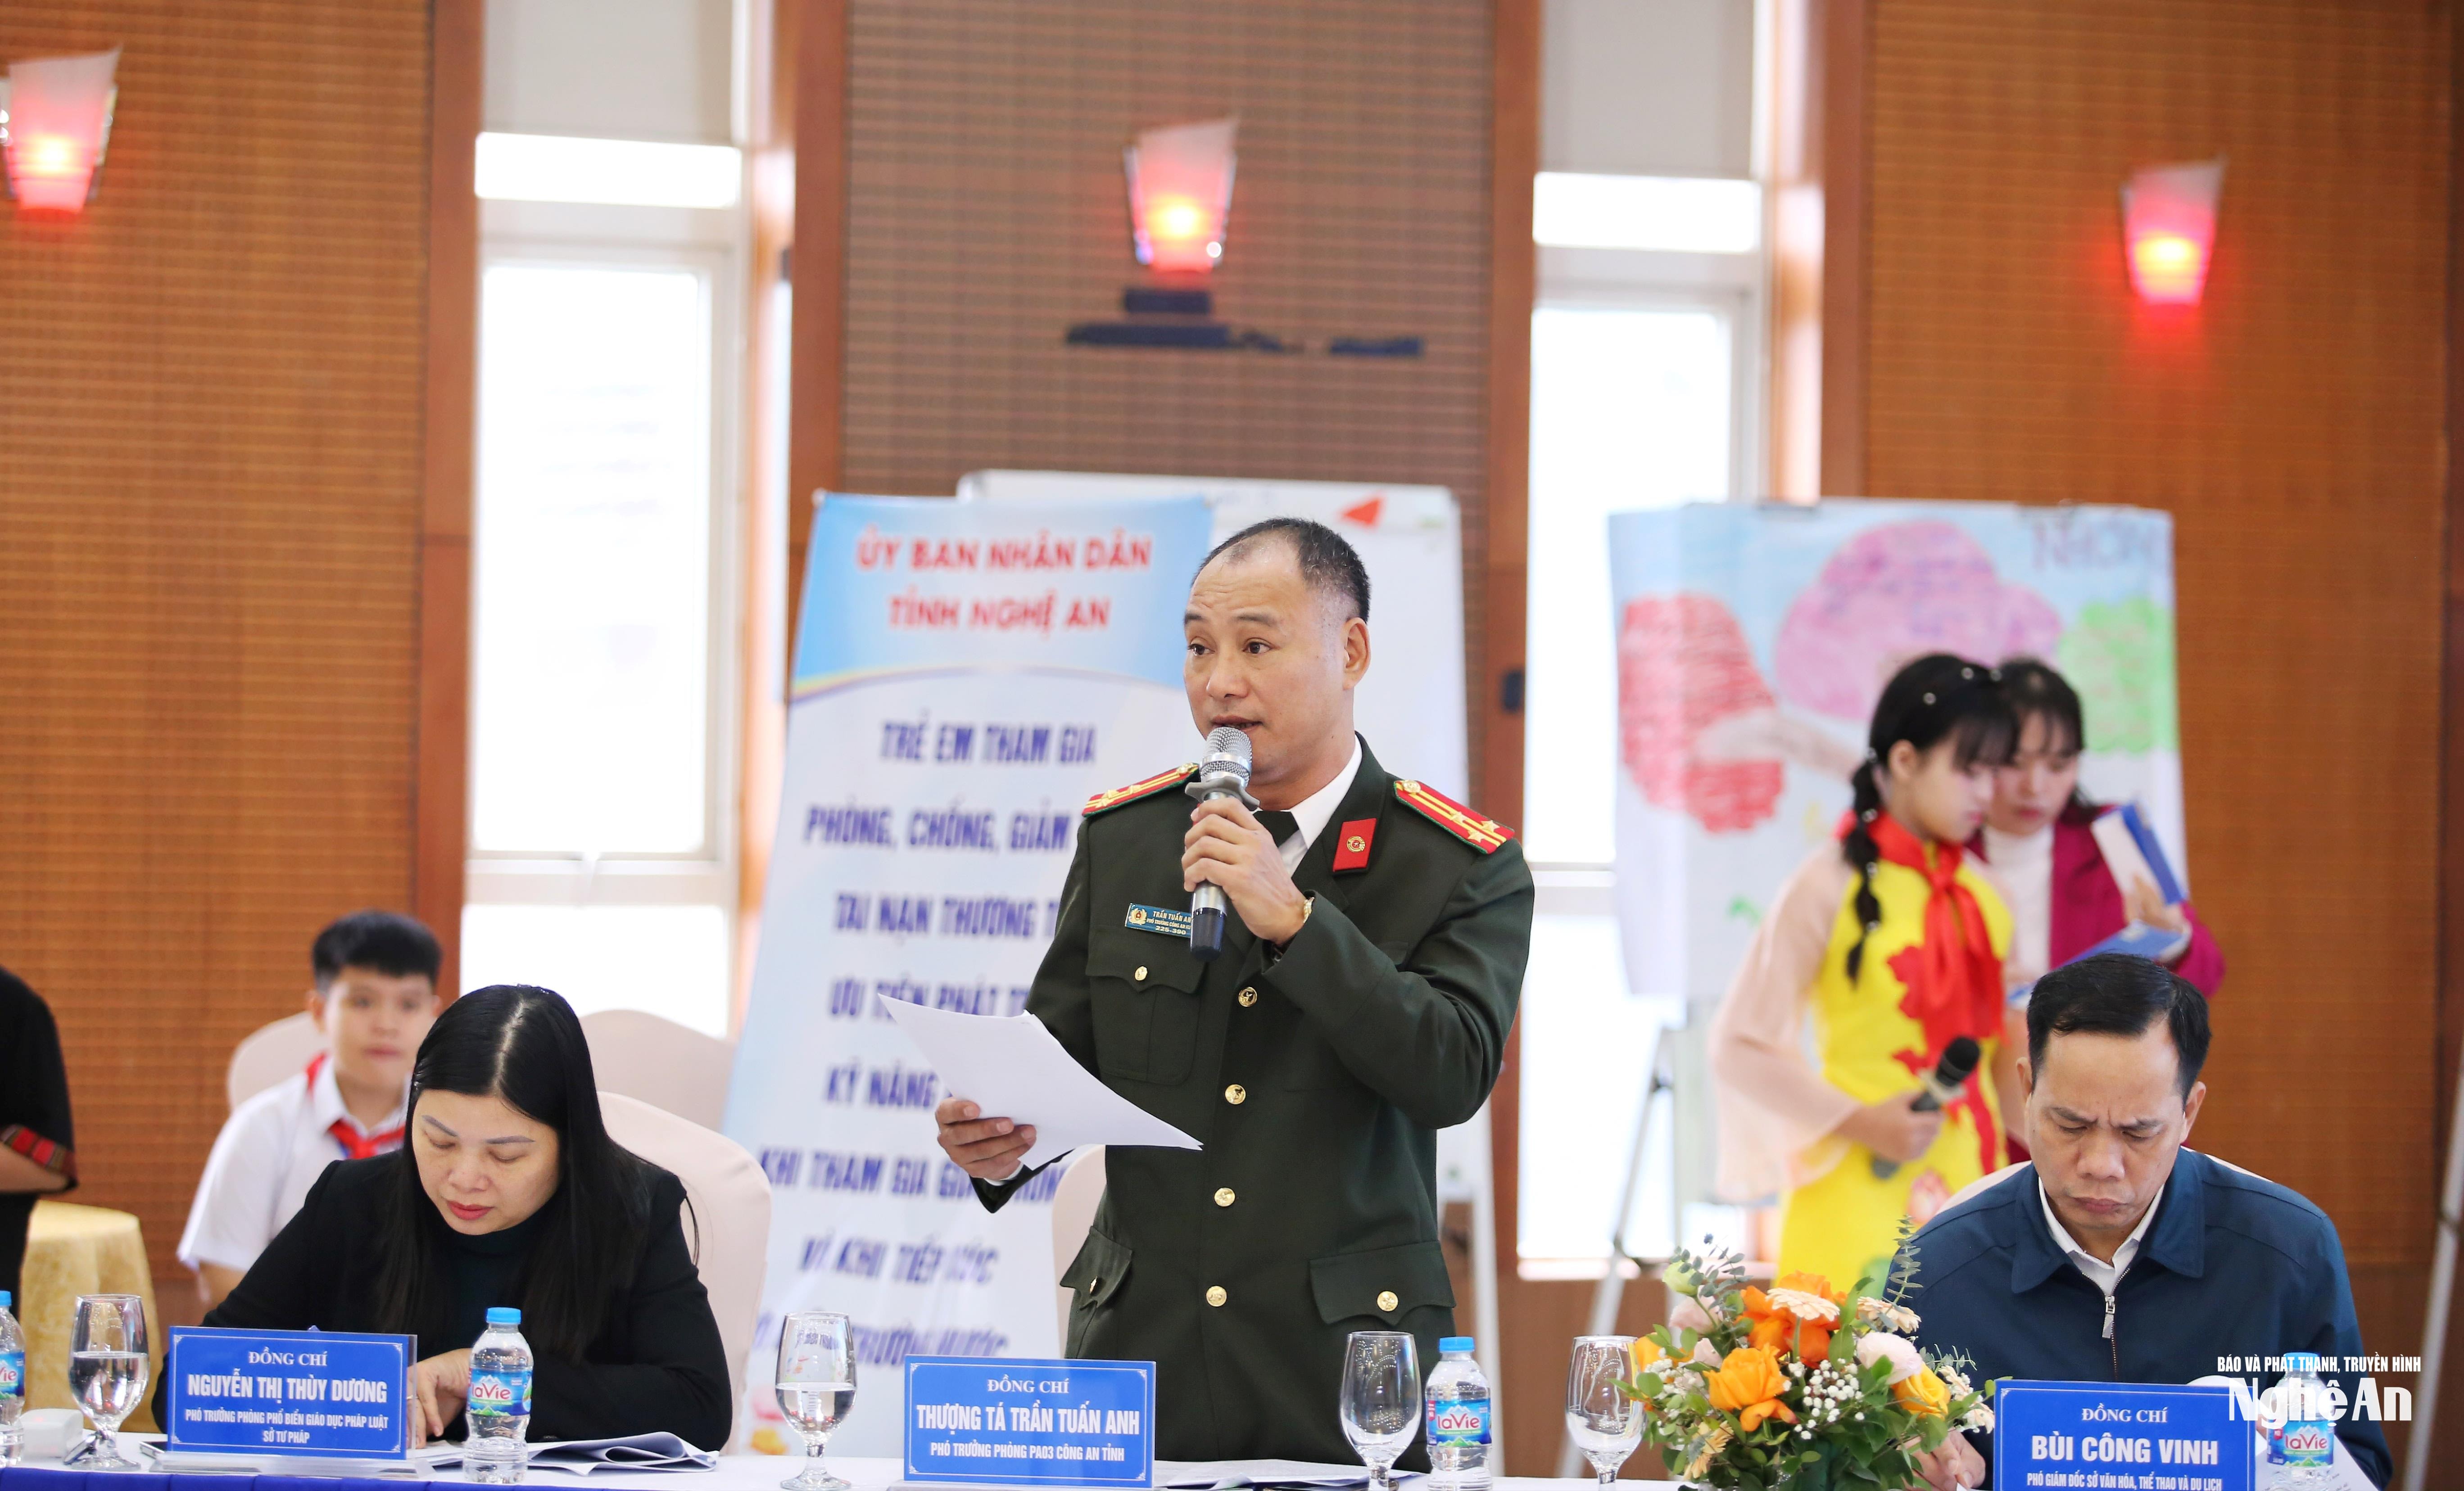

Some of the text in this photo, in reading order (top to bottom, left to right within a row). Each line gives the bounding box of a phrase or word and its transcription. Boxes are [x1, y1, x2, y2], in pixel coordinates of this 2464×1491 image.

[910, 537, 980, 569] BAN
[986, 528, 1076, 569] NHÂN
[1082, 526, 1151, 569] DÂN
[968, 587, 1056, 640] NGHỆ
[1064, 596, 1110, 628] AN
[935, 722, 975, 762] EM
[984, 723, 1051, 763] THAM
[1058, 725, 1096, 764] GIA
[809, 1150, 886, 1193] THAM
[892, 1155, 929, 1197] GIA
[248, 1346, 327, 1366] ĐỒNG CHÍ
[188, 1368, 387, 1404] NGUYỄN THỊ THÙY DƯƠNG
[472, 1383, 511, 1399] laVie
[987, 1374, 1069, 1393] ĐỒNG CHÍ
[186, 1407, 202, 1421] PHÓ
[204, 1406, 236, 1423] TRƯỞNG
[237, 1408, 265, 1424] PHÒNG
[267, 1408, 284, 1425] PHỔ
[306, 1411, 325, 1426] GIÁO
[326, 1414, 343, 1429] DỤC
[345, 1413, 367, 1428] PHÁP
[368, 1414, 389, 1431] LUẬT
[917, 1399, 1140, 1435] THƯỢNG TÁ TRẦN TUẤN ANH
[1437, 1413, 1480, 1429] laVie
[2082, 1402, 2168, 1423] ĐỒNG CHÍ
[263, 1427, 310, 1444] SỞ TƯ PHÁP
[2285, 1433, 2328, 1450] laVie
[931, 1440, 950, 1456] PHÓ
[953, 1439, 991, 1458] TRƯỞNG
[994, 1441, 1027, 1459] PHÒNG
[1056, 1443, 1083, 1460] CÔNG
[1086, 1446, 1100, 1461] AN
[1102, 1443, 1124, 1461] TỈNH
[2032, 1431, 2218, 1465] BÙI CÔNG VINH
[2027, 1470, 2043, 1486] PHÓ
[2045, 1471, 2066, 1486] GIÁM
[2068, 1470, 2084, 1487] ĐỐC
[2087, 1471, 2098, 1487] SỞ
[2100, 1472, 2116, 1488] VĂN
[2118, 1473, 2137, 1491] HÓA,
[2138, 1471, 2154, 1489] THỂ
[2156, 1476, 2175, 1490] THAO
[2178, 1475, 2189, 1491] VÀ
[2191, 1478, 2201, 1491] DU
